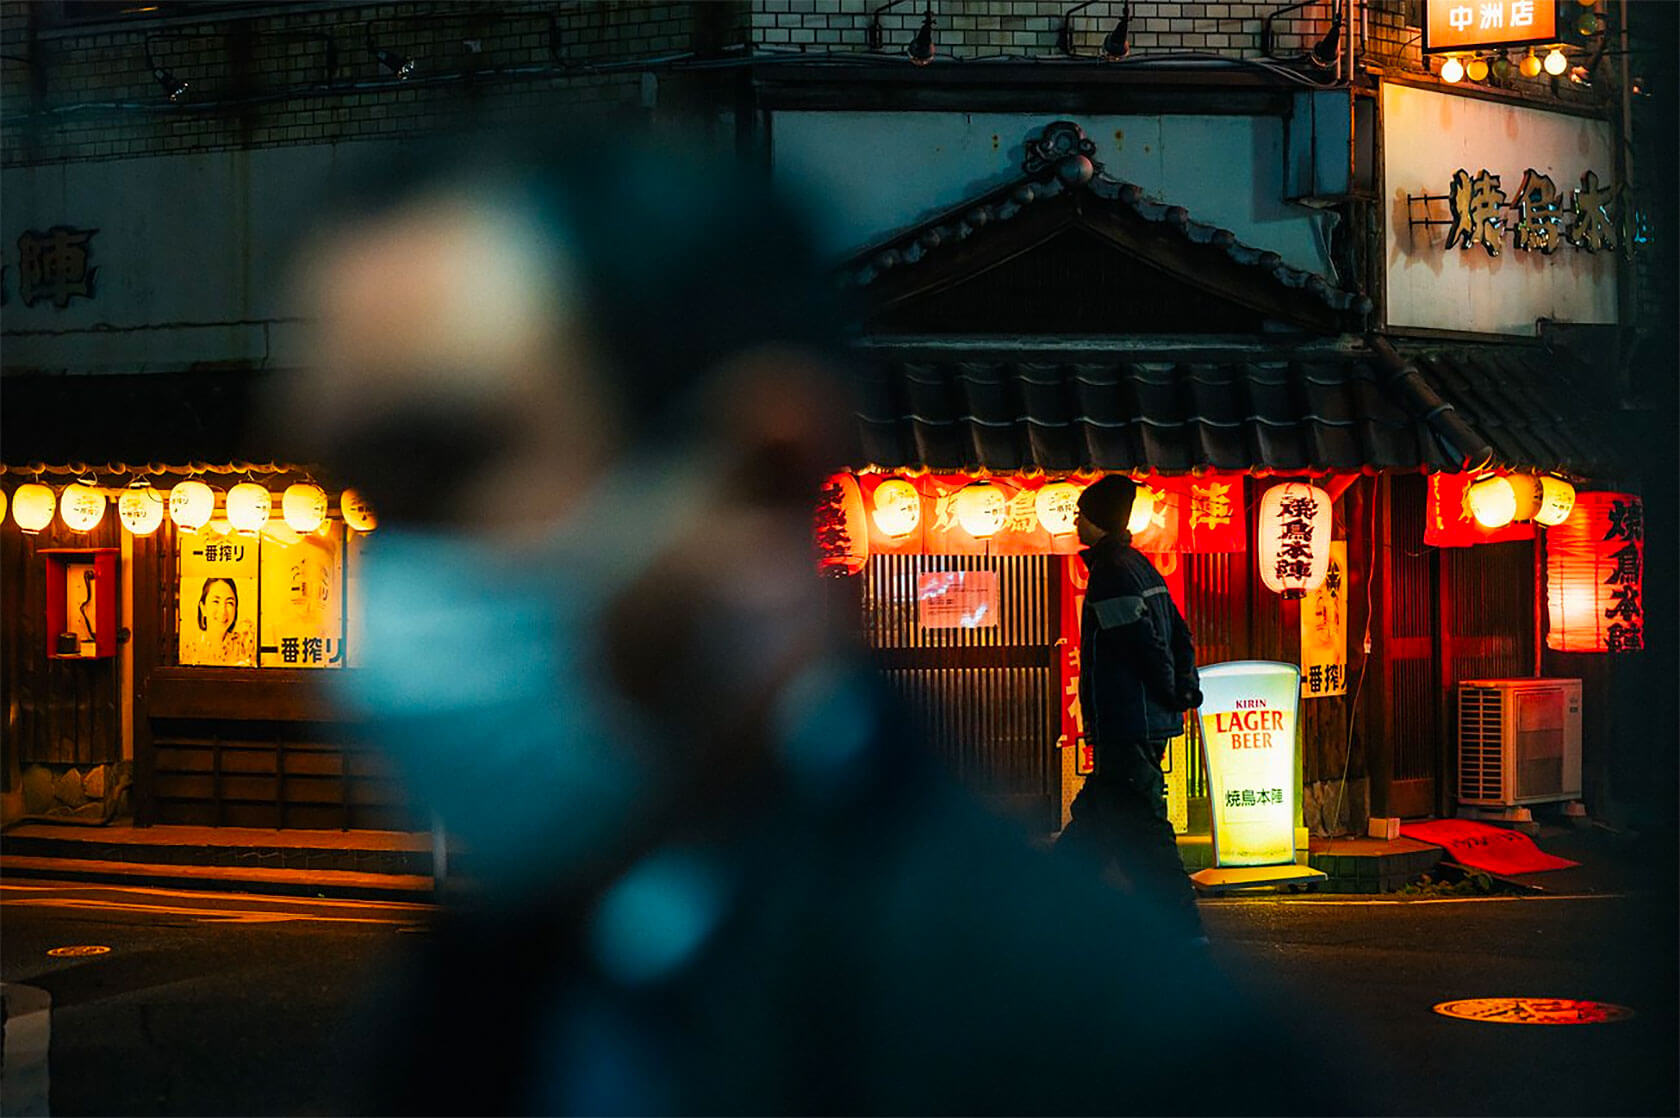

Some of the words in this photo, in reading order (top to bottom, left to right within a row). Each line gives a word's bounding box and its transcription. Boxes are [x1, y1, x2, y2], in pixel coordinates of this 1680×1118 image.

[1449, 1, 1534, 31] 中洲店
[0, 225, 100, 308] 陣
[1275, 497, 1318, 580] 焼鳥本陣
[193, 545, 244, 562] 一番搾り
[260, 637, 343, 663] 一番搾り
[1235, 699, 1267, 709] KIRIN
[1215, 710, 1284, 733] LAGER
[1232, 732, 1273, 749] BEER
[1225, 788, 1284, 807] 焼鳥本陣
